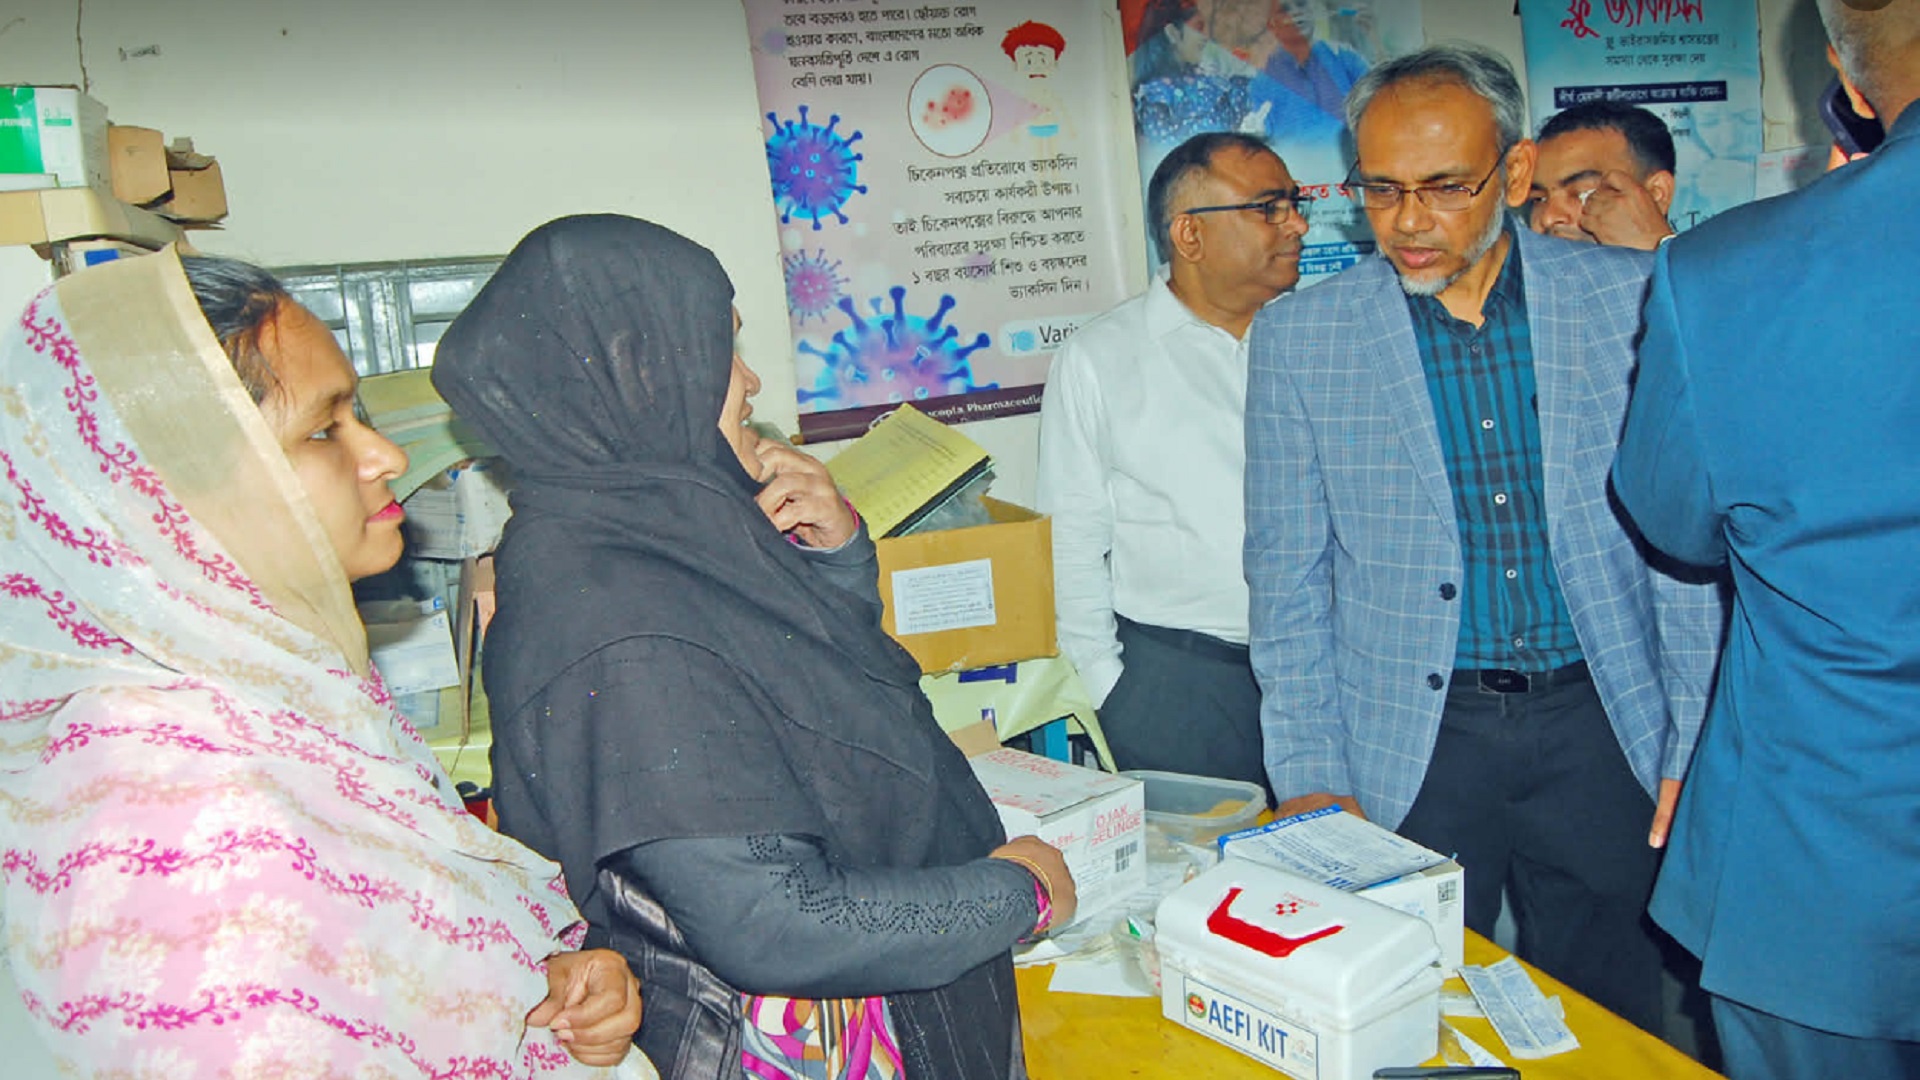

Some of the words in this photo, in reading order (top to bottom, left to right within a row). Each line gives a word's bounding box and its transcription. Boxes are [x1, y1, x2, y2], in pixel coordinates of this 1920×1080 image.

[953, 6, 977, 18] রোগ
[857, 51, 880, 63] দেশে
[895, 50, 920, 62] রোগ
[1030, 154, 1078, 173] ভ্যাকসিন
[1040, 206, 1082, 221] আপনার
[914, 240, 969, 258] পরিবারের
[1051, 231, 1085, 244] করতে
[924, 268, 950, 282] বছর
[1009, 279, 1058, 299] ভ্যাকসিন
[1038, 322, 1079, 343] Vari
[1208, 999, 1251, 1041] AEFI
[1257, 1019, 1289, 1059] KIT
